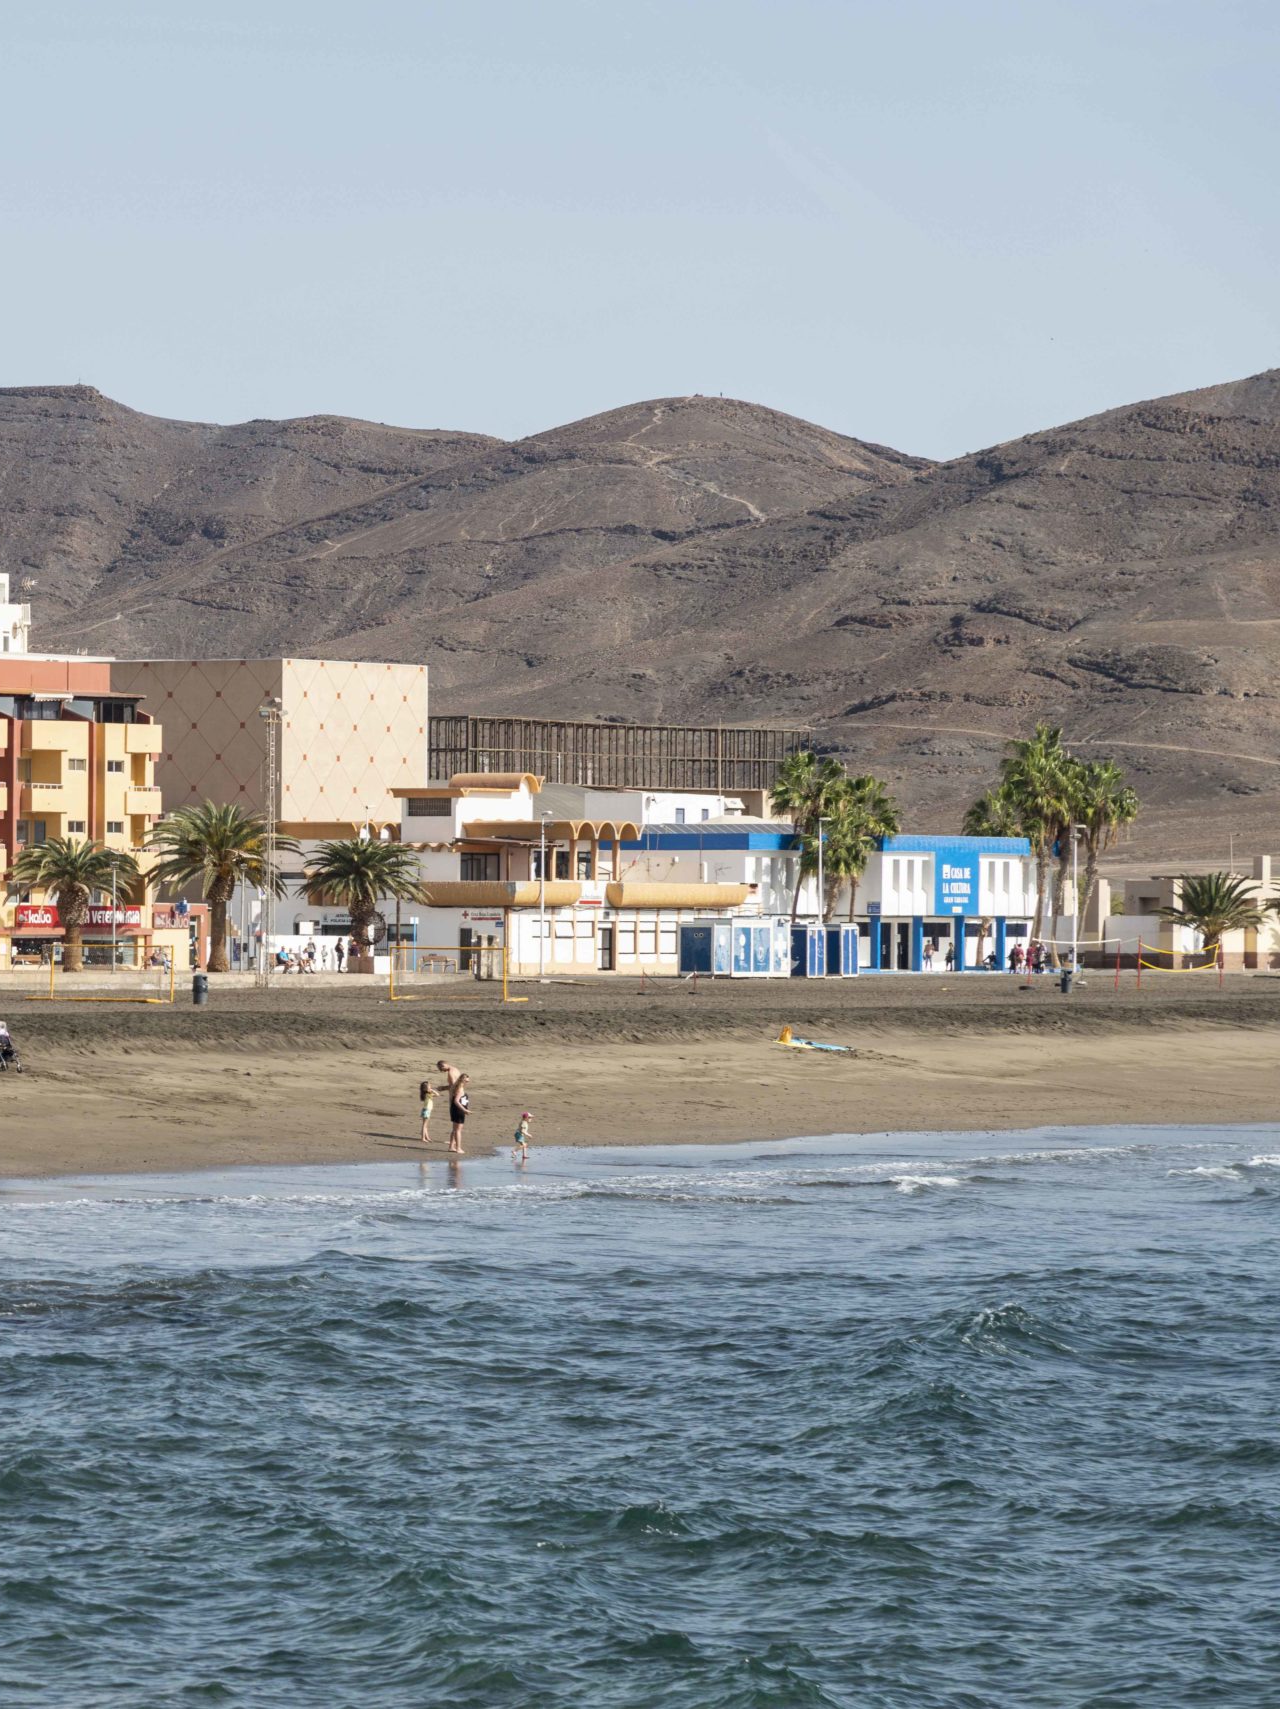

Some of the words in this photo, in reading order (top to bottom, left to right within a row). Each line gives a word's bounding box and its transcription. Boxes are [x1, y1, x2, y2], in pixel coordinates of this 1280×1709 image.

[951, 868, 963, 879] CASA
[964, 868, 970, 879] DE
[942, 882, 948, 894] LA
